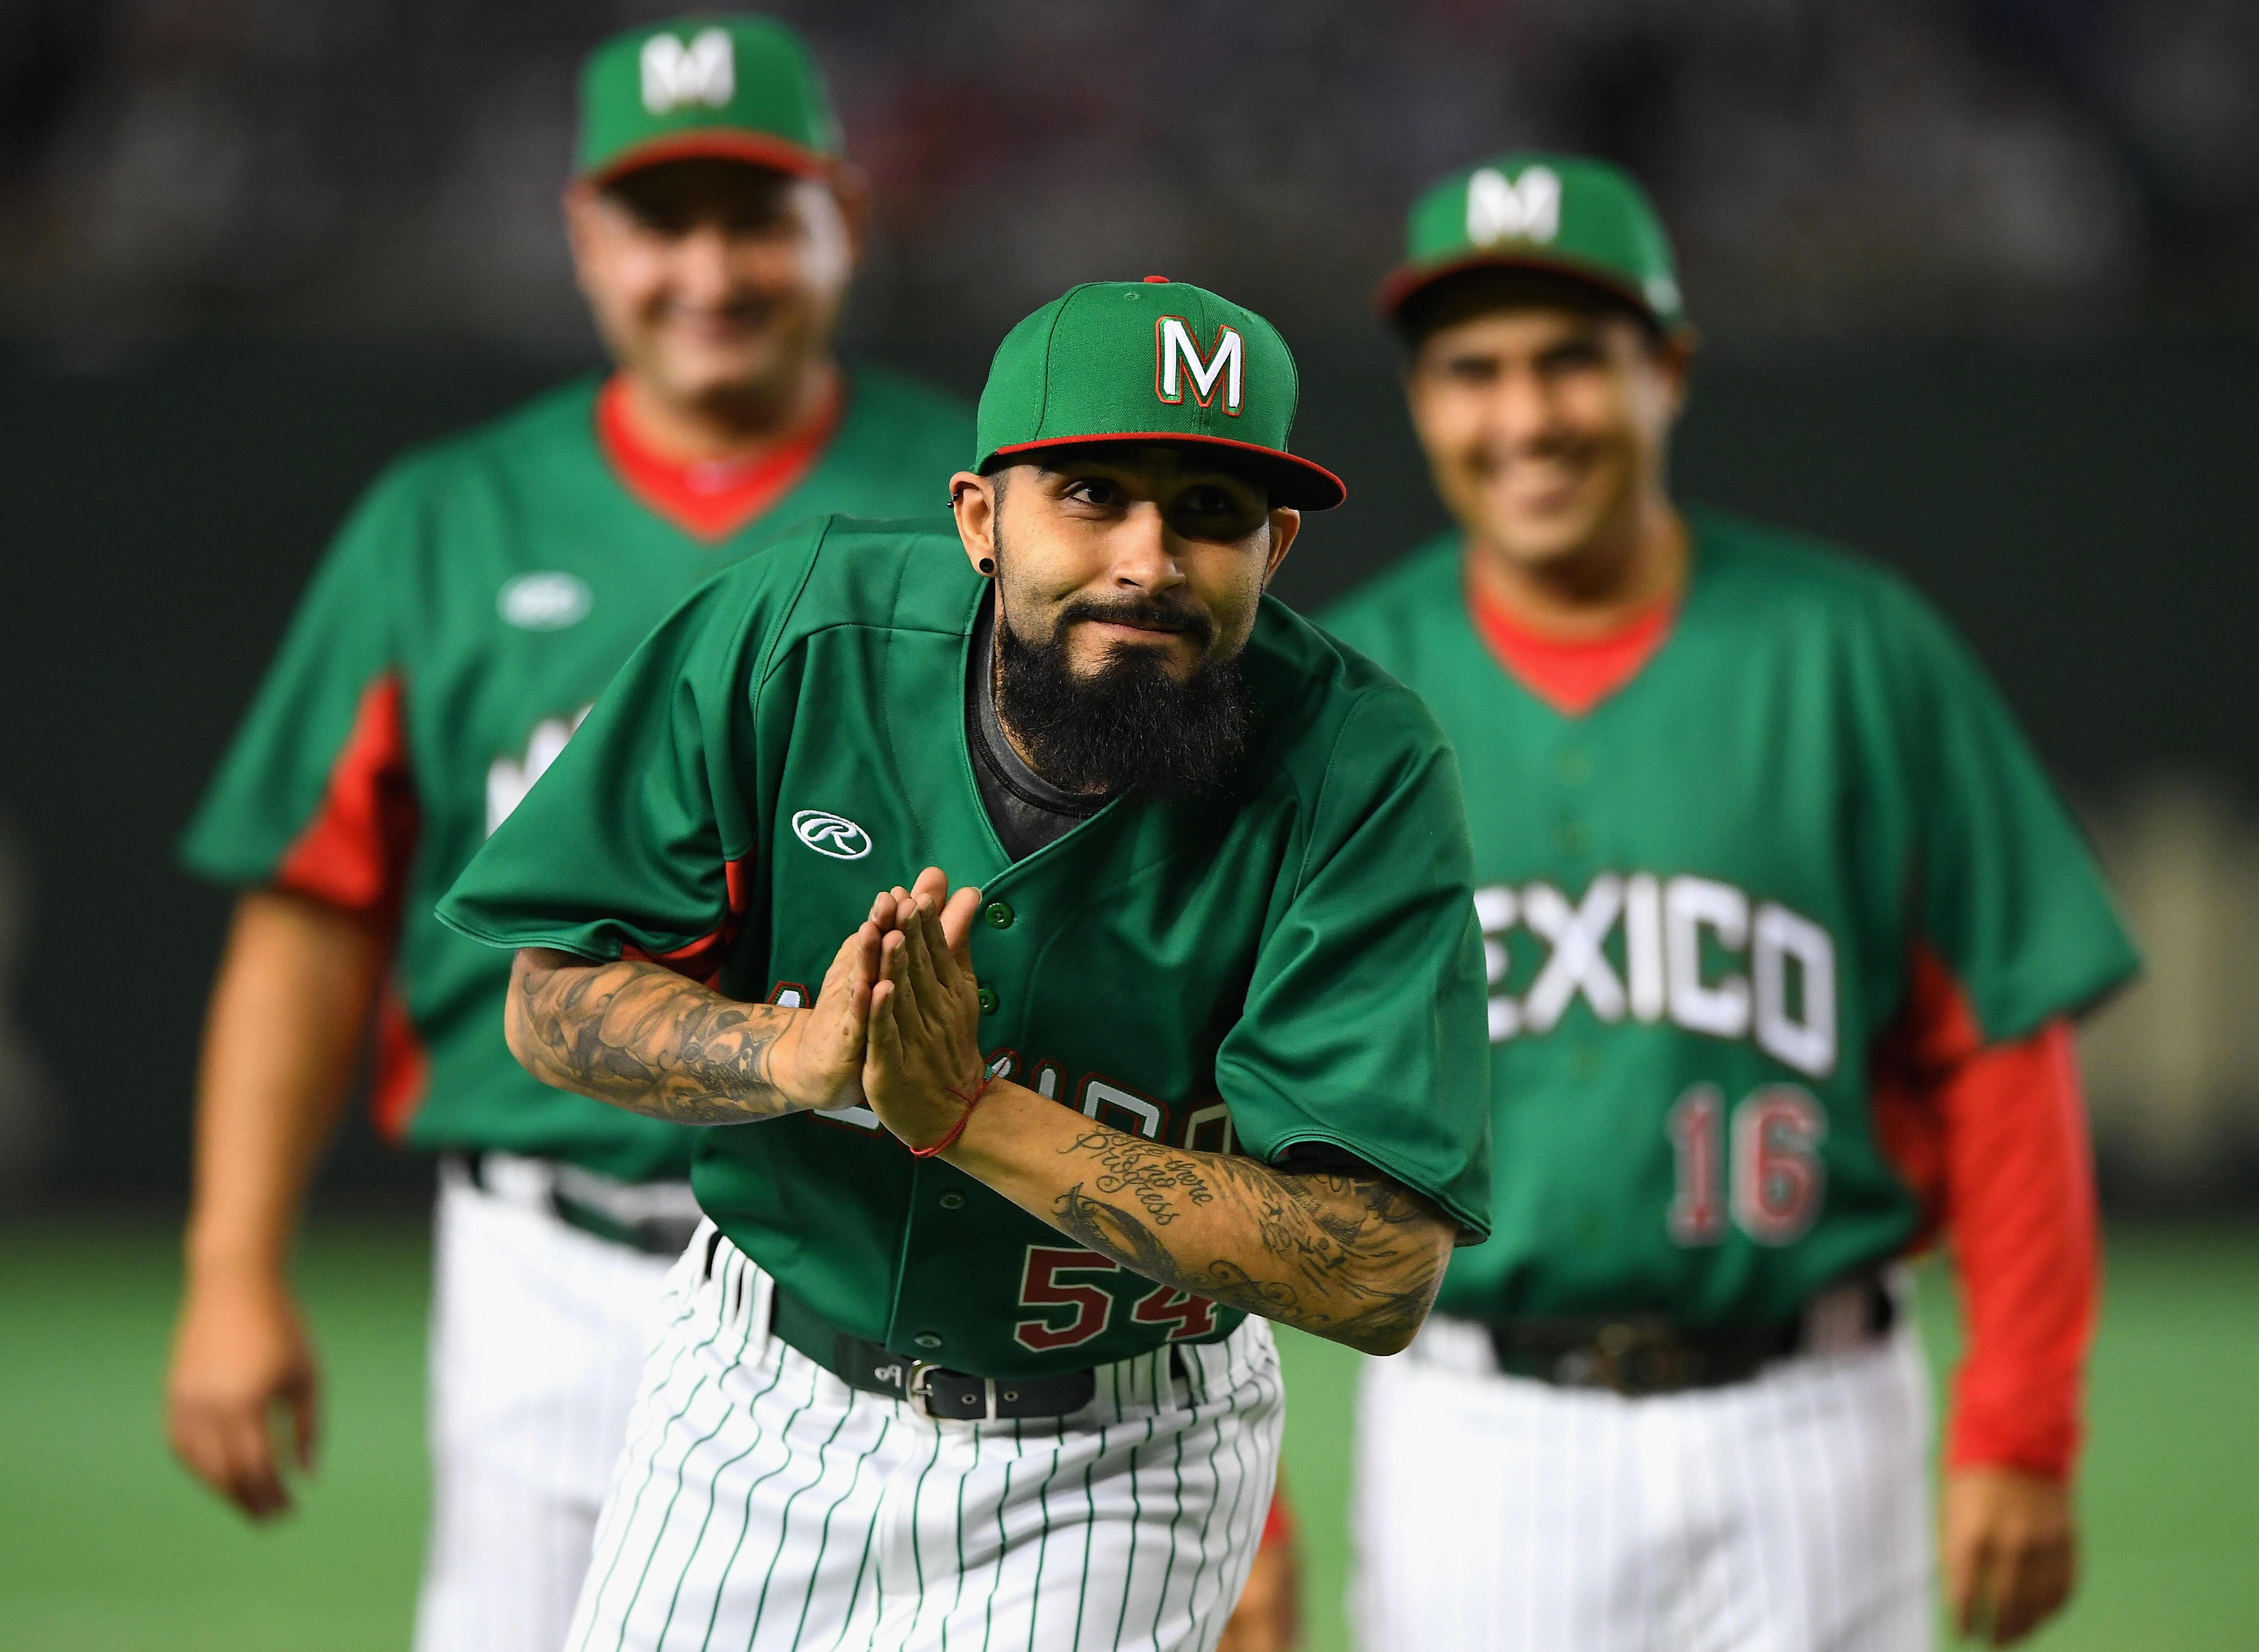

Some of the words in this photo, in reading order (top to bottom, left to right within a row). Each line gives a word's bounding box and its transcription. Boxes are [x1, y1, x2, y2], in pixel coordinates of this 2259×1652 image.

[642, 27, 735, 114] M
[1467, 165, 1560, 246] M
[1155, 315, 1245, 417] M
[1474, 871, 1837, 1079] EXICO
[1164, 1155, 1214, 1207] there
[1667, 1081, 1827, 1247] 16
[1014, 1244, 1218, 1352] 54
